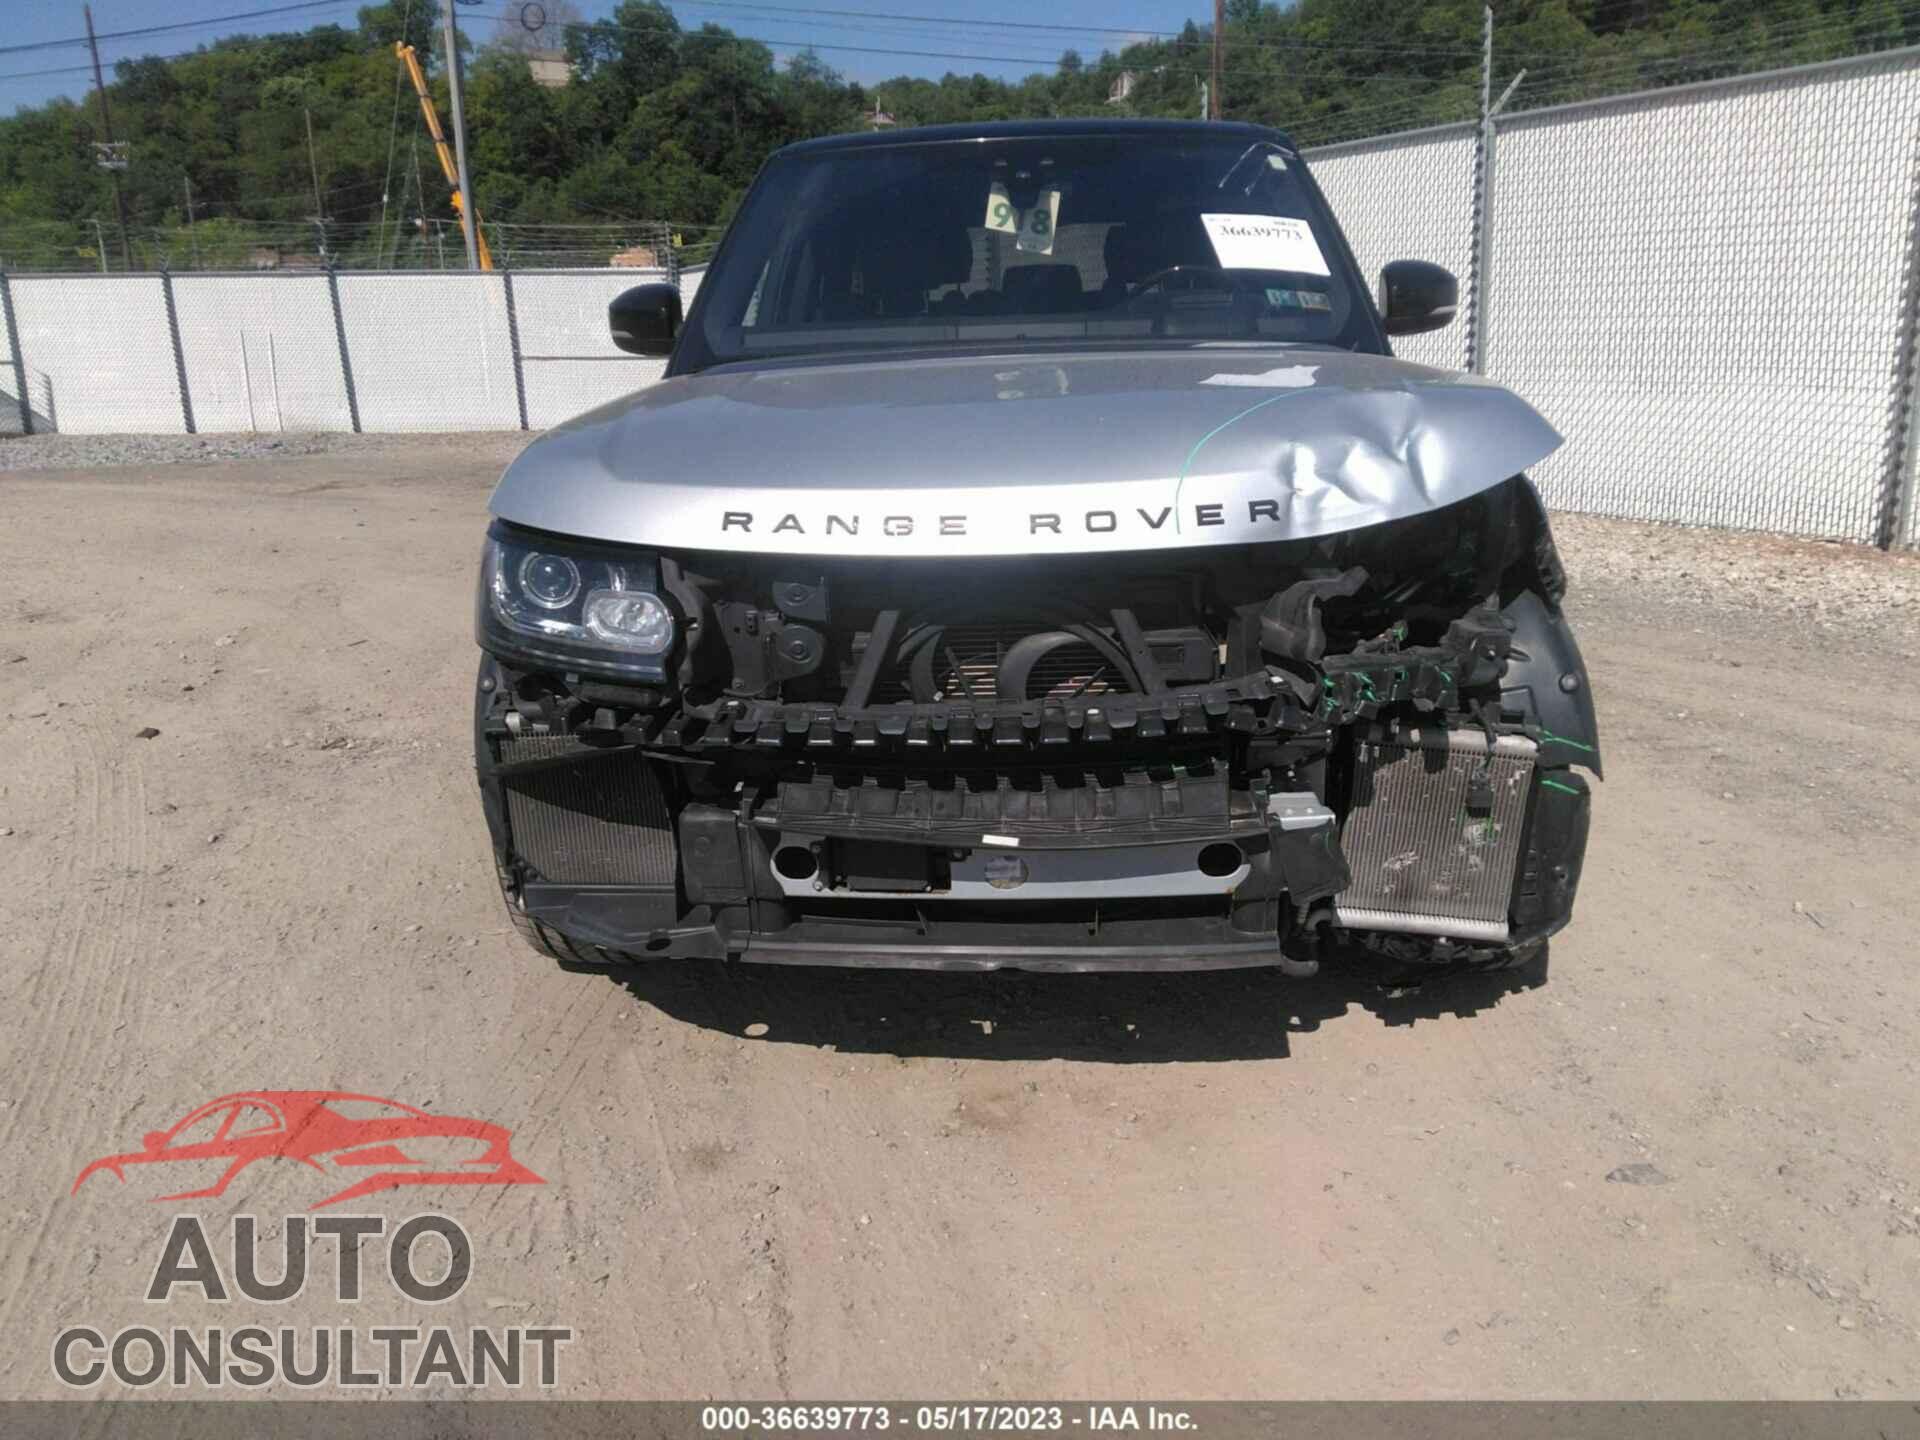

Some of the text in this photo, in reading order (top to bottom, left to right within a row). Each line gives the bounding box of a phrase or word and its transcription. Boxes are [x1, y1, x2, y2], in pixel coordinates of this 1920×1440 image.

[1220, 224, 1304, 242] 36639773
[721, 499, 1281, 537] RANGE ROVER
